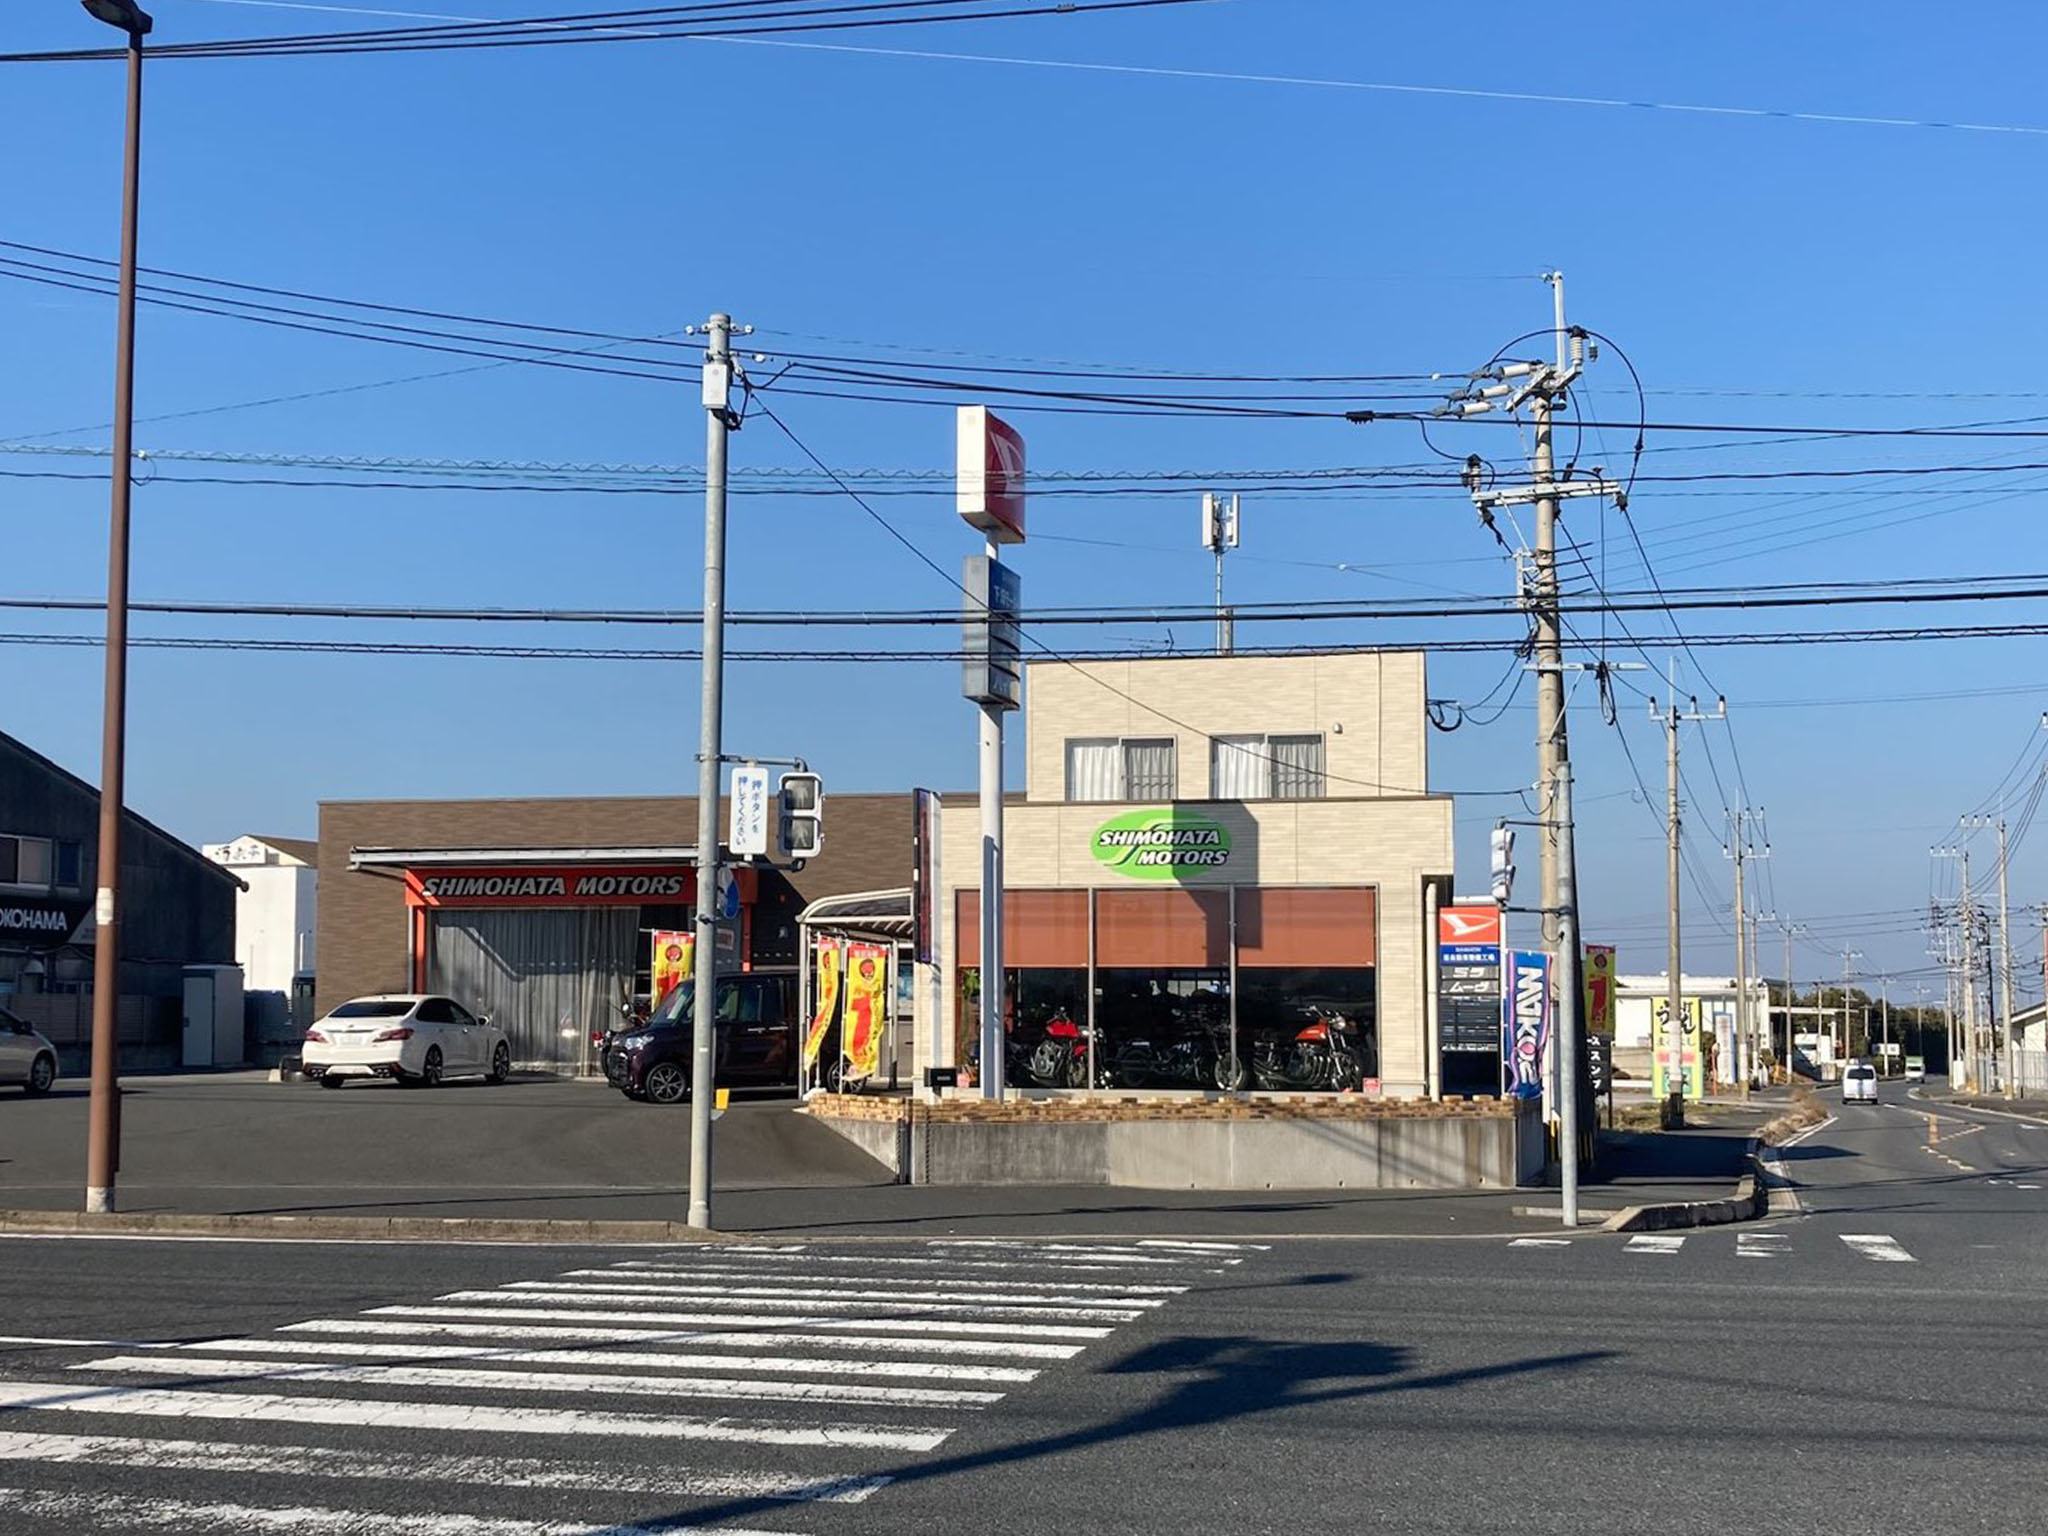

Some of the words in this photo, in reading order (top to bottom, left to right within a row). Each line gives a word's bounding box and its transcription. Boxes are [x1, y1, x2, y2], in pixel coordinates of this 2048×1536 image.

[1099, 829, 1221, 846] SHIMOHATA
[1136, 850, 1229, 866] MOTORS
[423, 877, 567, 896] SHIMOHATA
[574, 876, 684, 896] MOTORS
